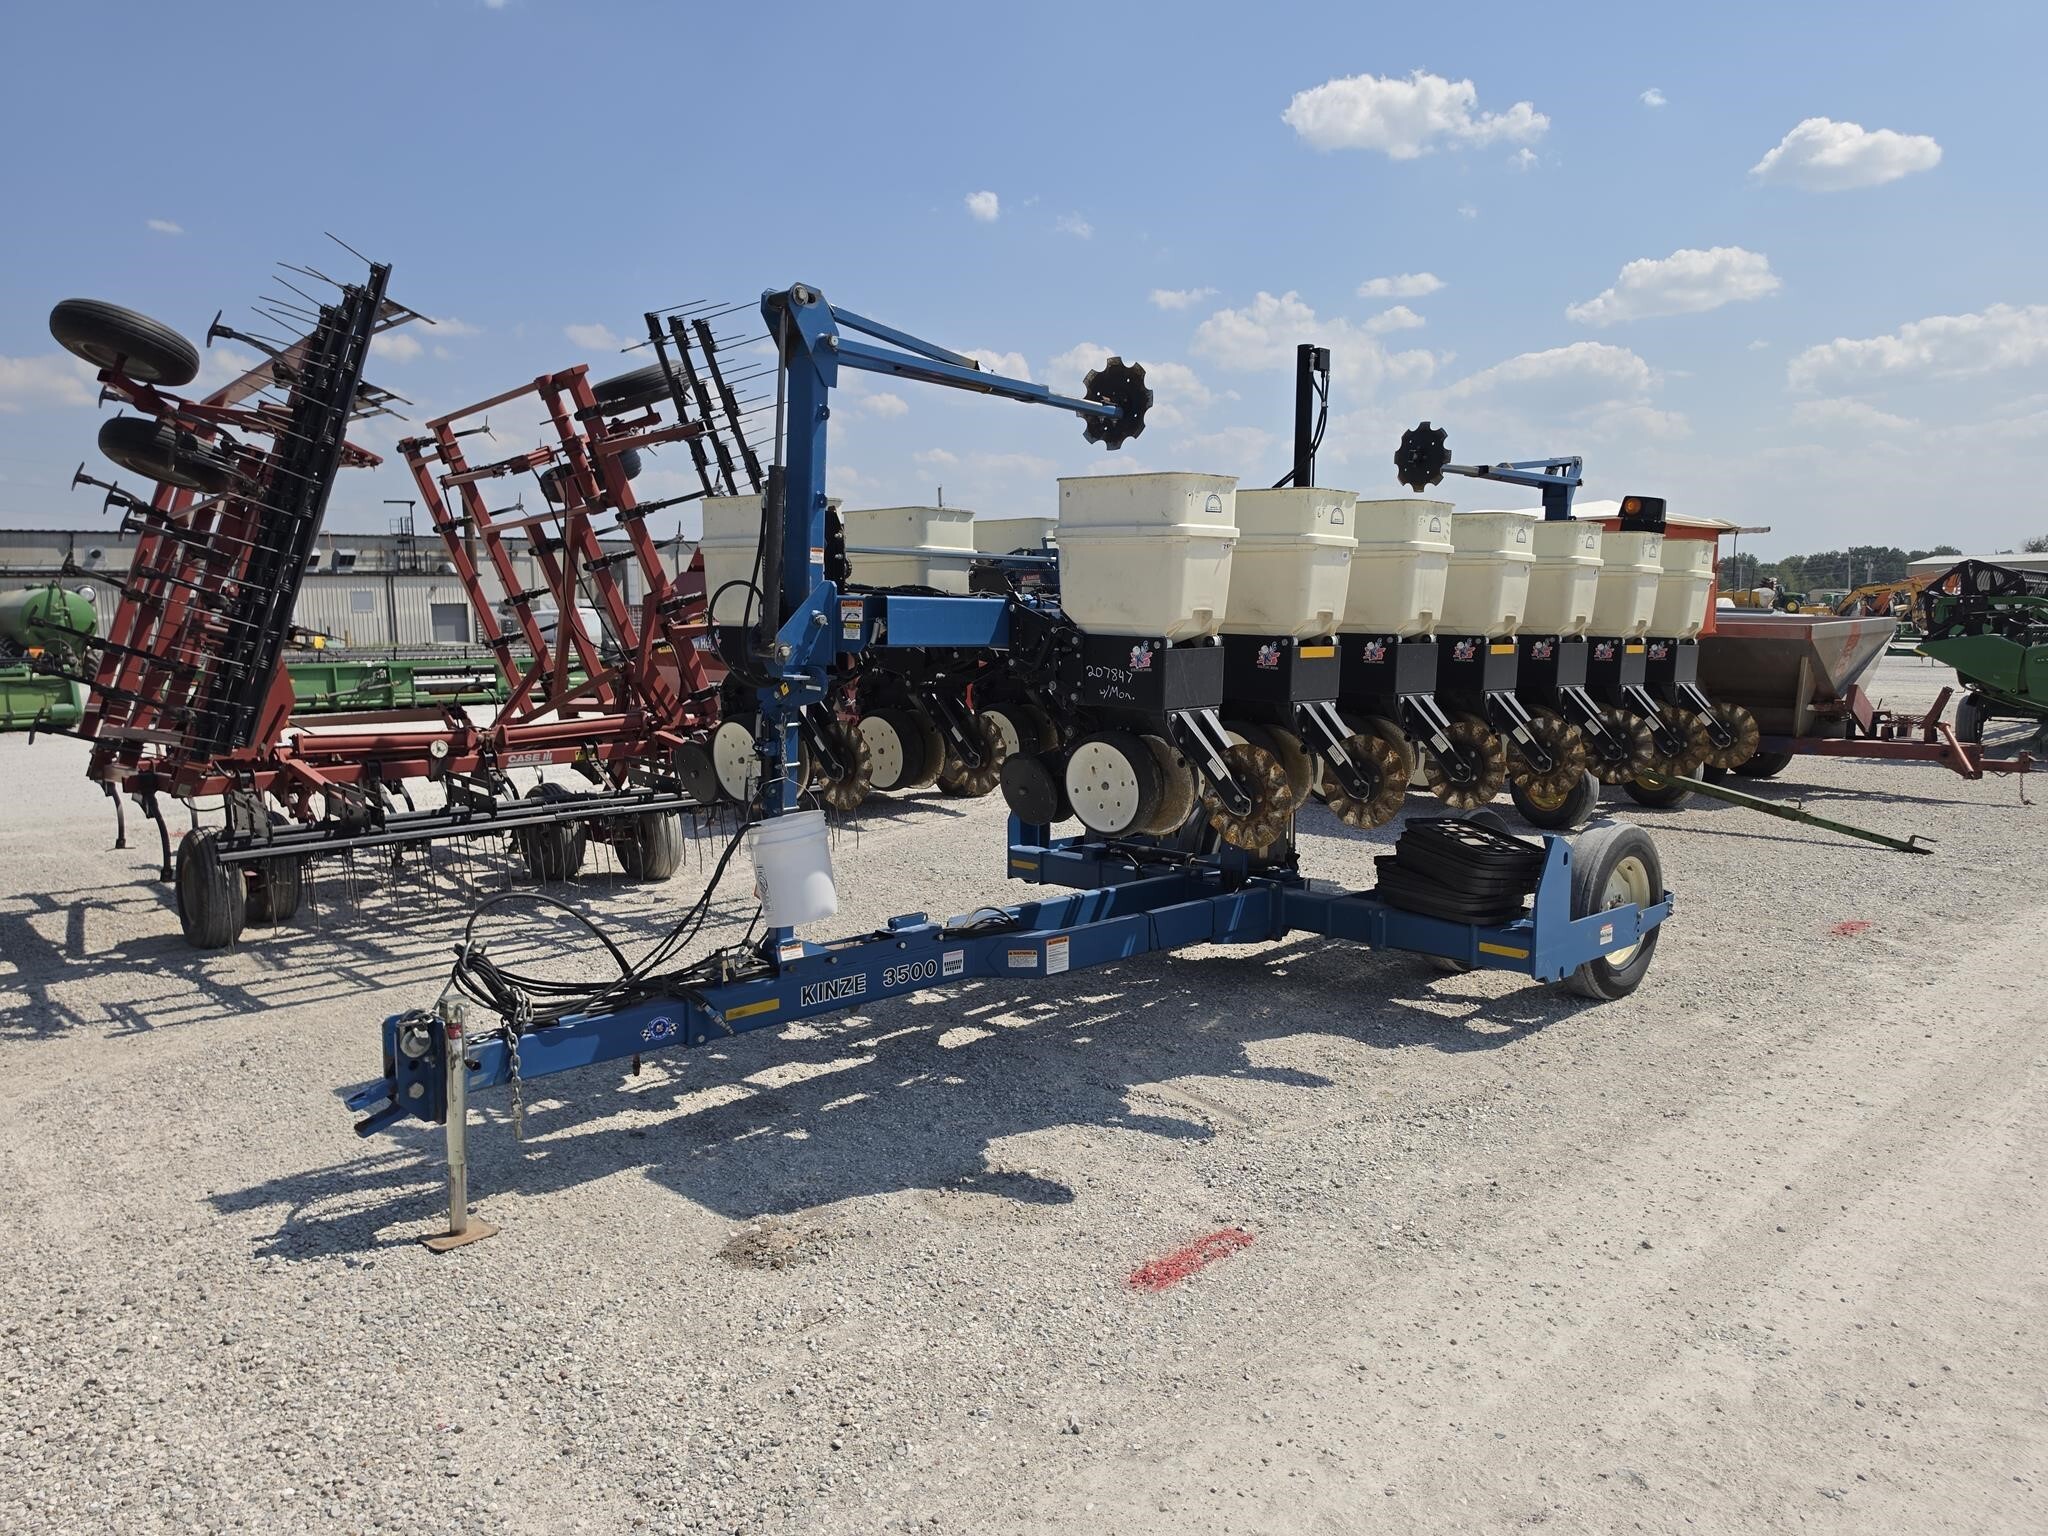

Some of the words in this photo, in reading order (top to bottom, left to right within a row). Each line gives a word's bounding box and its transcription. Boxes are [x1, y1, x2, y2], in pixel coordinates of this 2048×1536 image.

[1086, 665, 1133, 683] 207847
[508, 753, 541, 763] CASE
[800, 973, 867, 1007] KINZE
[882, 959, 938, 988] 3500
